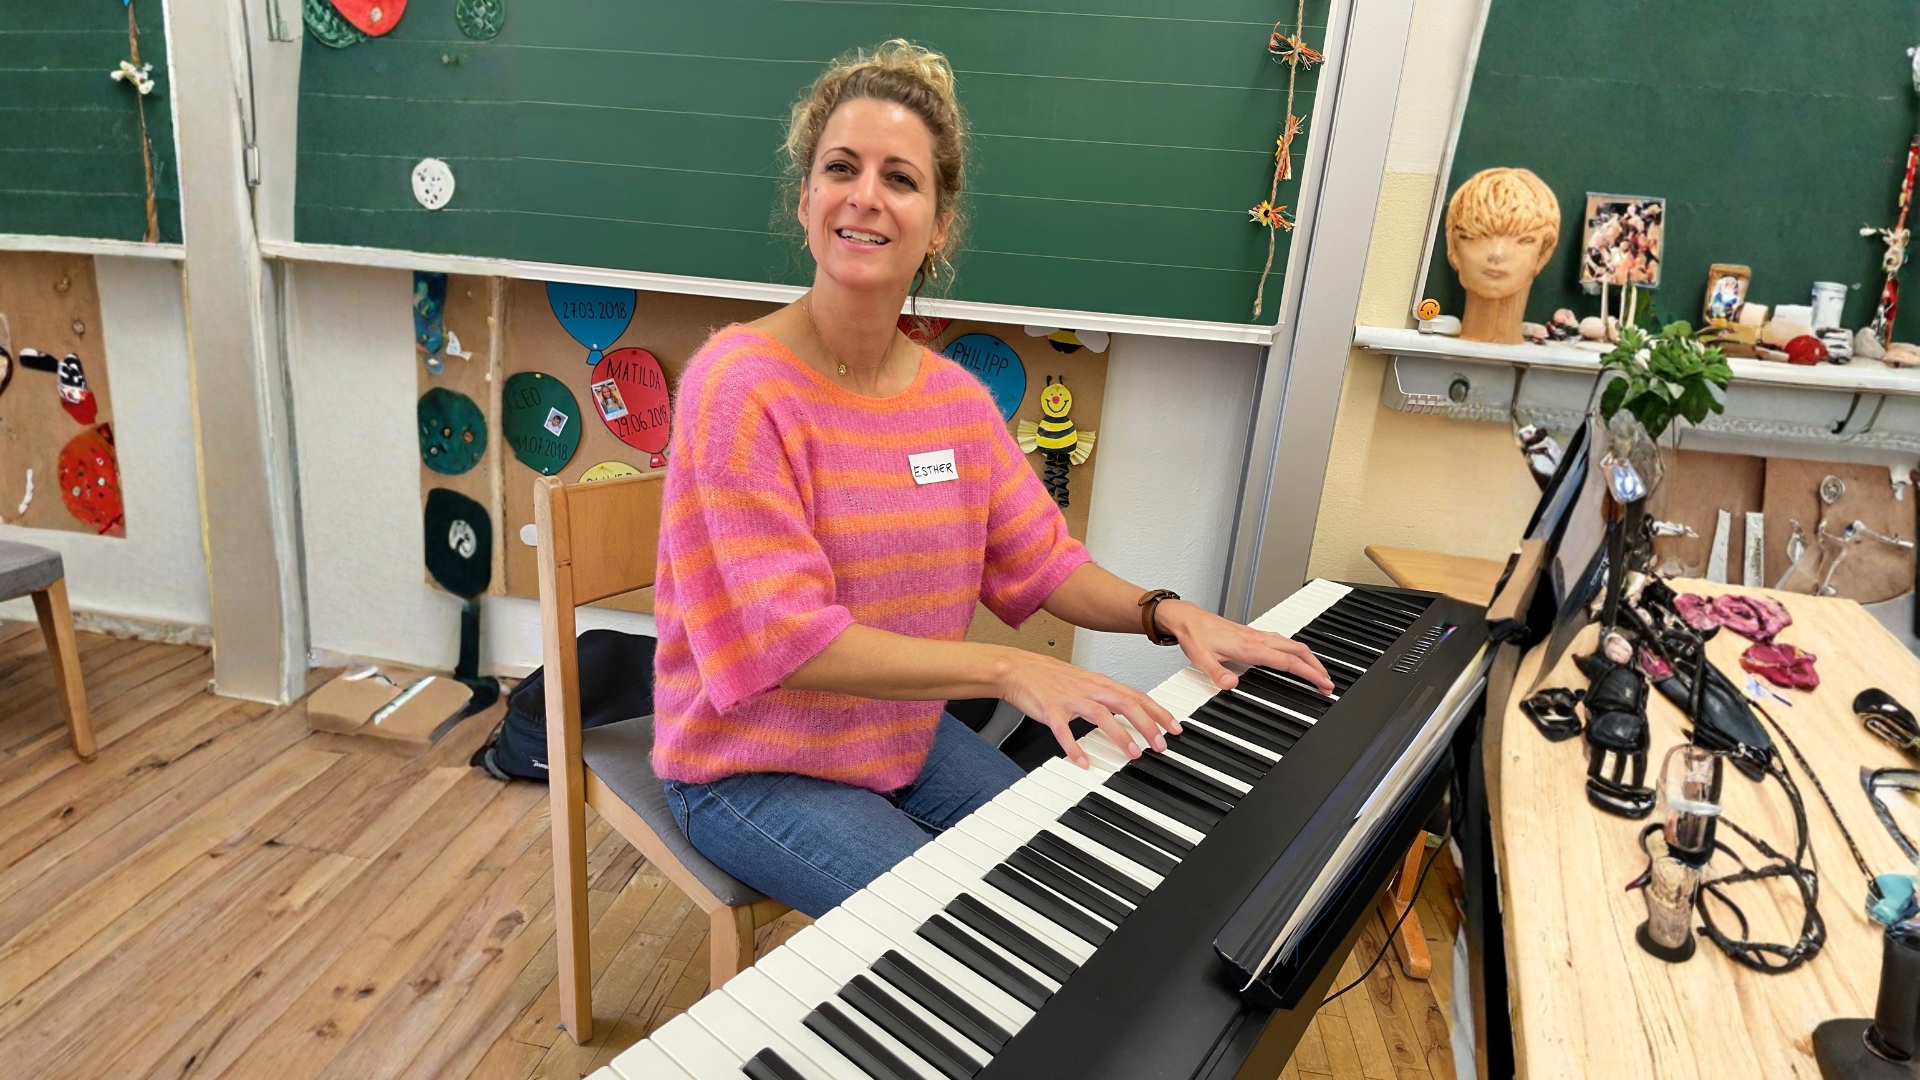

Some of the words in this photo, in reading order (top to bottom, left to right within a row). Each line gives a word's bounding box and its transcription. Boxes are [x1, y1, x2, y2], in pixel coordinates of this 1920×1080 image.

[563, 301, 627, 319] 27.03.2018
[952, 342, 1009, 377] PHILIPP
[606, 357, 661, 391] MATILDA
[514, 434, 568, 461] 31.07.2018
[913, 462, 954, 478] ESTHER
